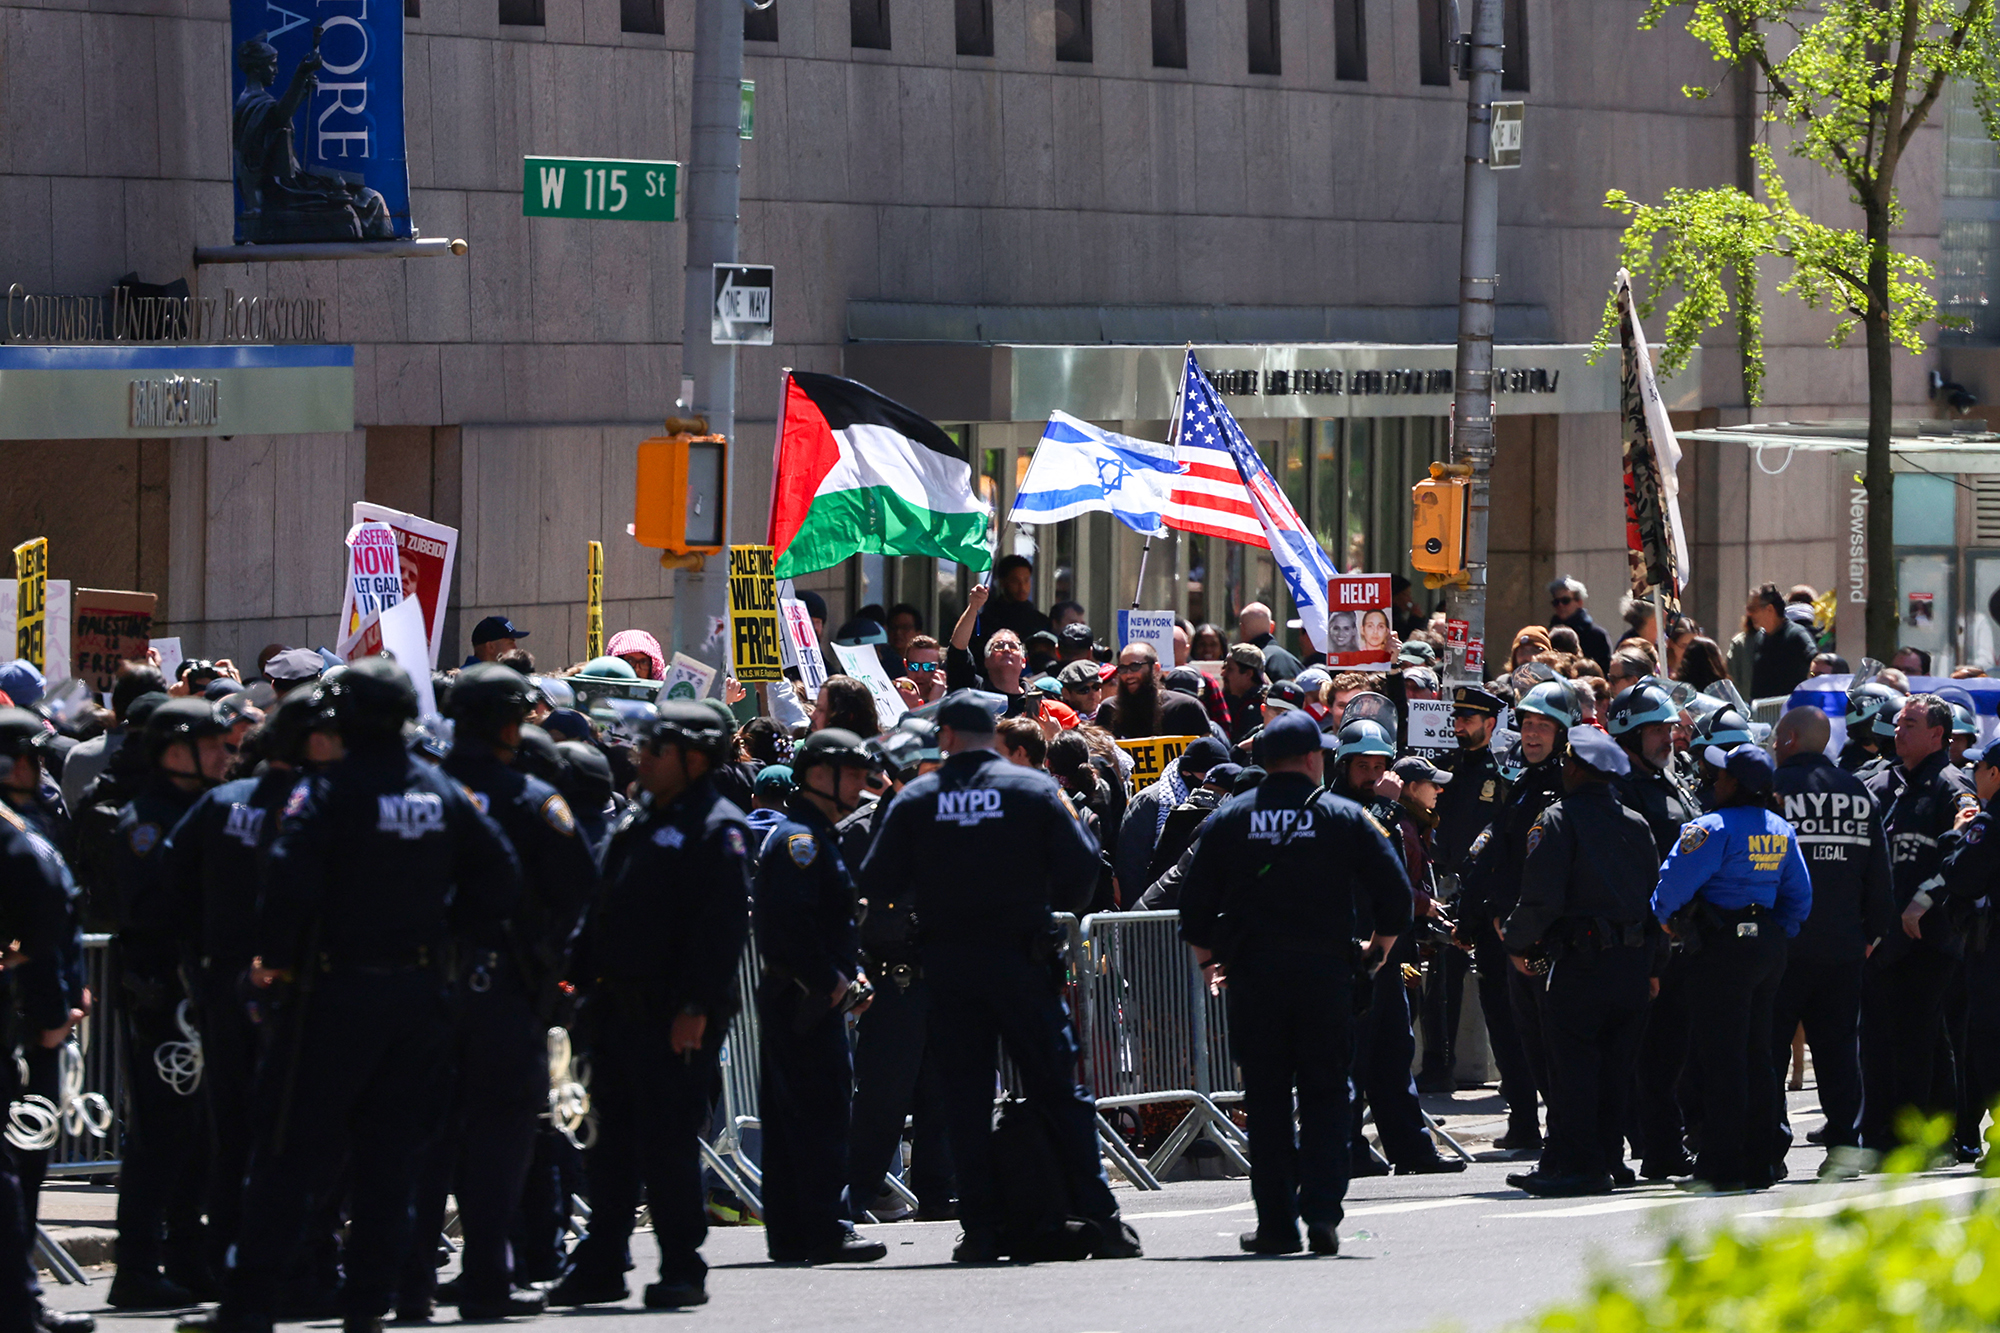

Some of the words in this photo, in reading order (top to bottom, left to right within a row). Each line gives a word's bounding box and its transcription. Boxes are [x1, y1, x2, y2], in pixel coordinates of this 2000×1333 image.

[540, 166, 566, 209] W
[583, 168, 628, 212] 115
[645, 170, 666, 197] St
[6, 282, 104, 341] COLUMBIA
[223, 286, 326, 341] BOOKSTORE
[724, 289, 741, 318] ONE
[749, 290, 767, 318] WAY
[406, 534, 447, 560] ZUBEIDI
[1849, 487, 1869, 604] Newsstand
[354, 545, 395, 576] NOW
[355, 577, 371, 594] LET
[374, 576, 401, 594] GAZA
[1340, 582, 1380, 604] HELP!
[1129, 629, 1160, 640] STANDS
[1130, 617, 1151, 628] NEW
[1152, 617, 1172, 627] YORK
[1413, 702, 1452, 712] PRIVATE
[938, 788, 1001, 814] NYPD
[1784, 792, 1871, 820] NYPD
[1250, 809, 1314, 833] NYPD
[1748, 834, 1788, 853] NYPD
[1812, 845, 1848, 861] LEGAL
